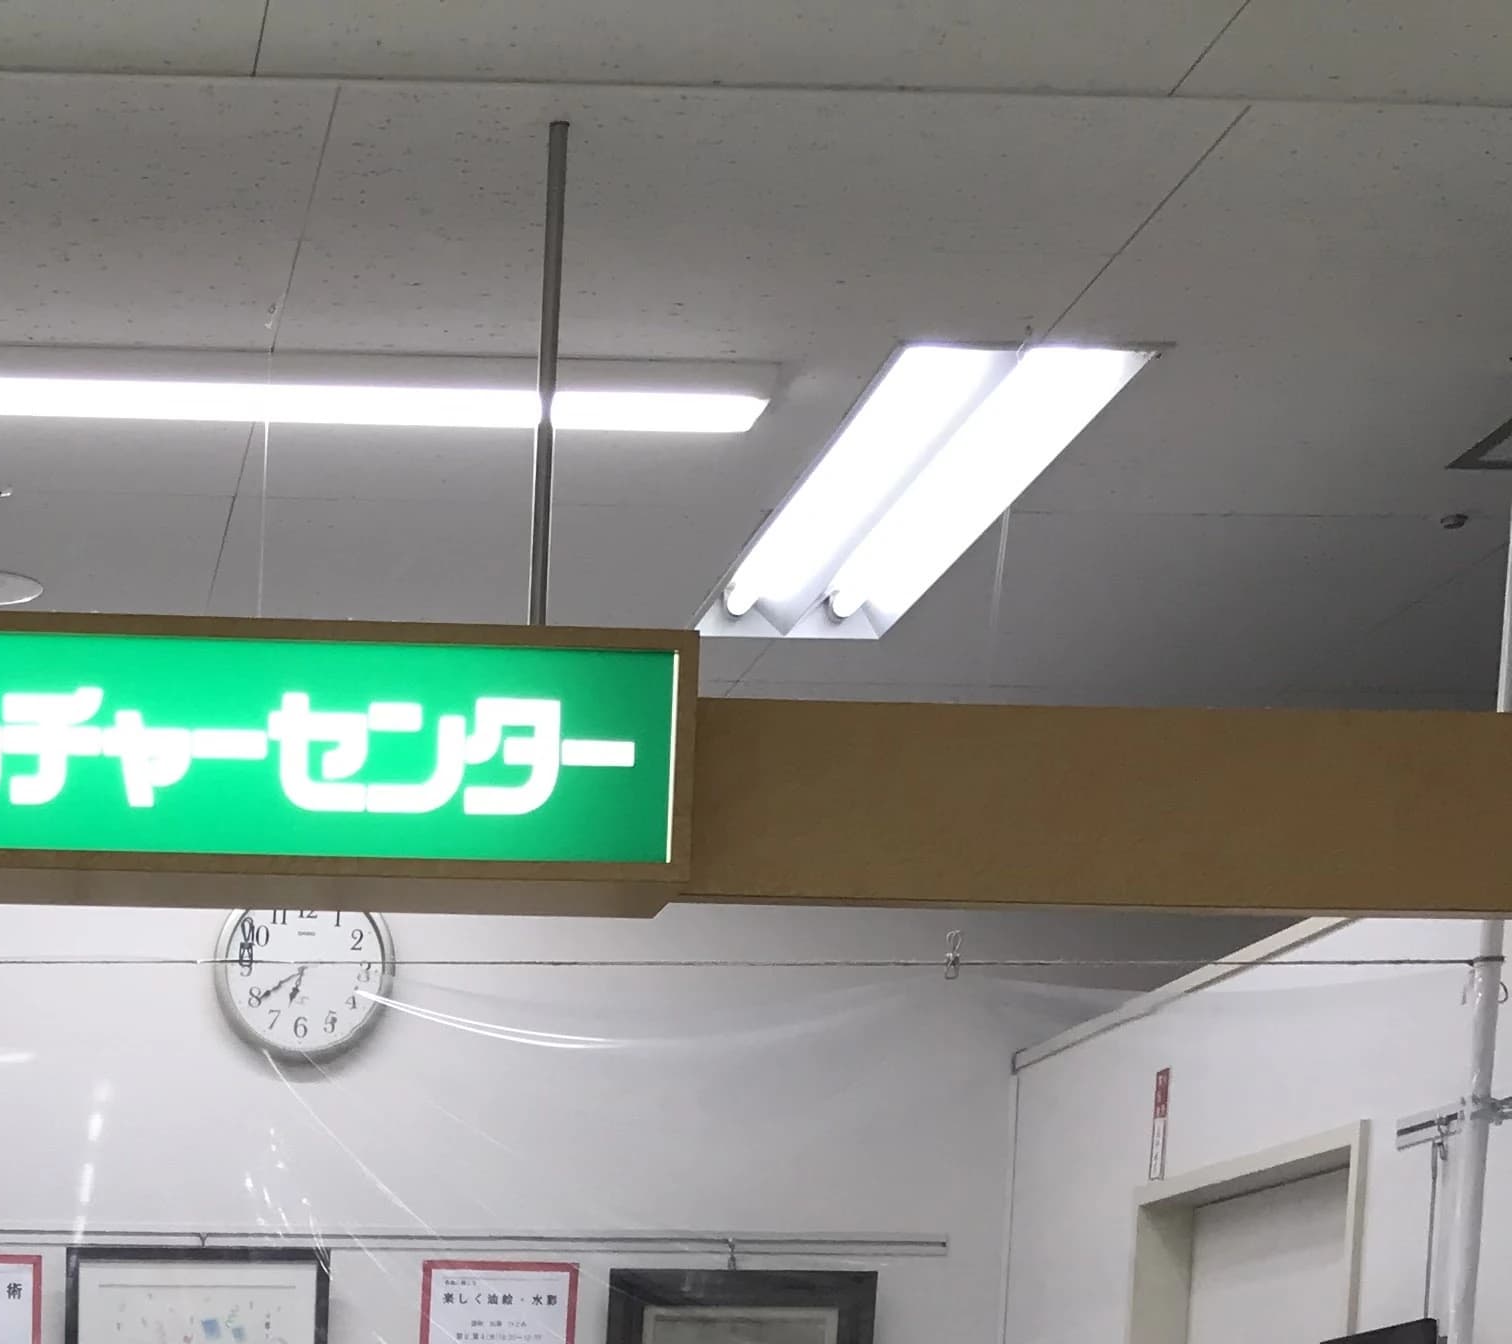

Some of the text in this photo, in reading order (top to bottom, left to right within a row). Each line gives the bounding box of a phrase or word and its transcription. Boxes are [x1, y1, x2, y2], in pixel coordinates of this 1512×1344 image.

[350, 929, 364, 950] 2
[248, 986, 262, 1008] 8
[268, 1009, 281, 1030] 7
[293, 1016, 308, 1038] 6
